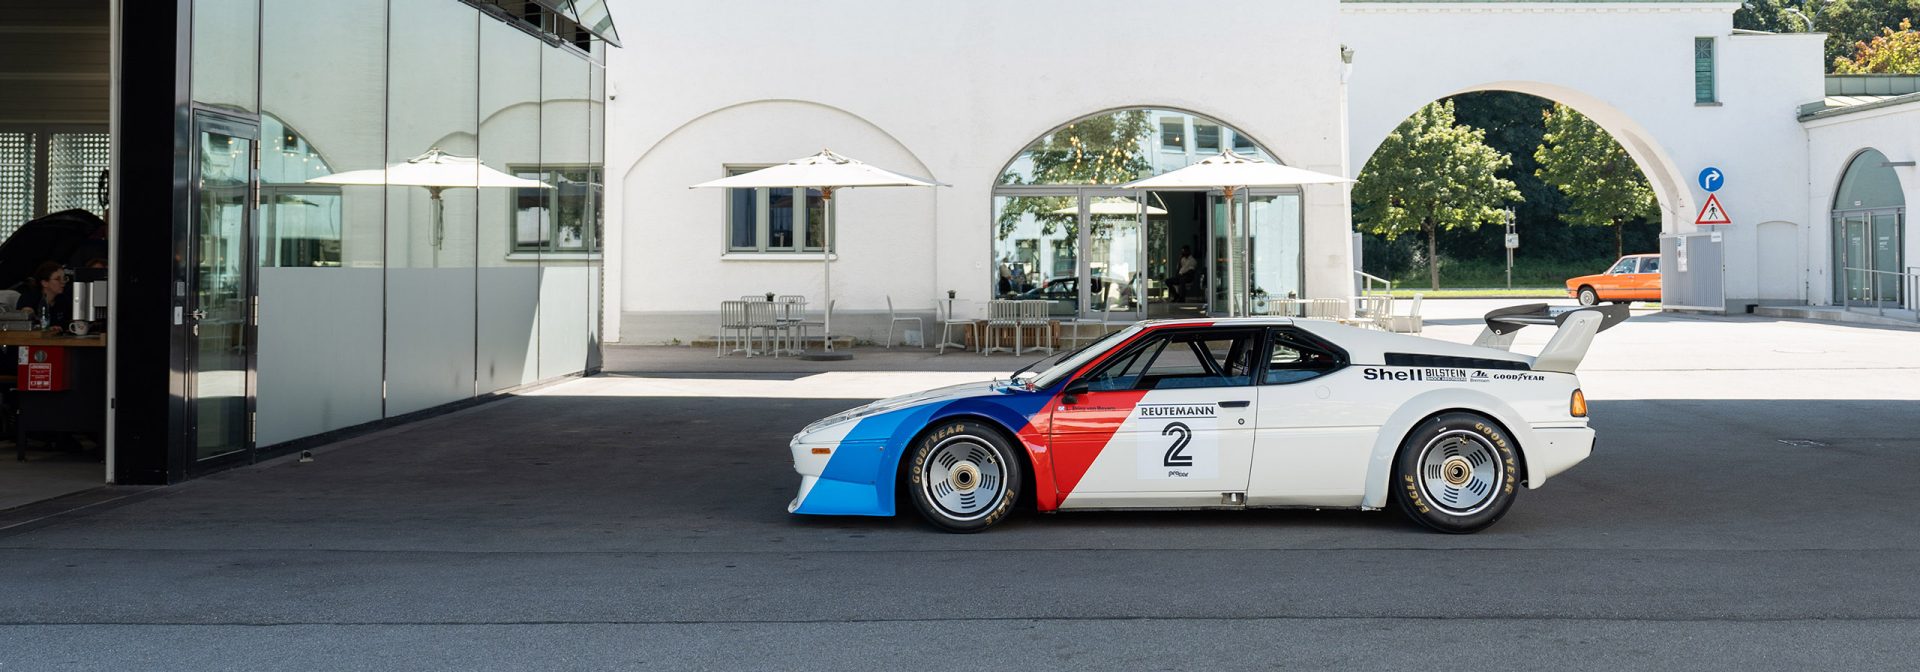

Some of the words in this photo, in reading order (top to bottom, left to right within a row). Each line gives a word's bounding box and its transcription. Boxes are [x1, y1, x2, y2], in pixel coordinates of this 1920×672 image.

[1363, 368, 1423, 381] Shell
[1425, 368, 1466, 378] BILSTEIN
[1493, 372, 1545, 381] GOODYEAR
[1141, 406, 1214, 416] REUTEMANN
[912, 424, 965, 484] GOODYEAR
[1161, 421, 1193, 467] 2
[1475, 422, 1515, 495] GOODYEAR
[985, 488, 1015, 526] EAGLE
[1404, 474, 1430, 514] EAGLE
